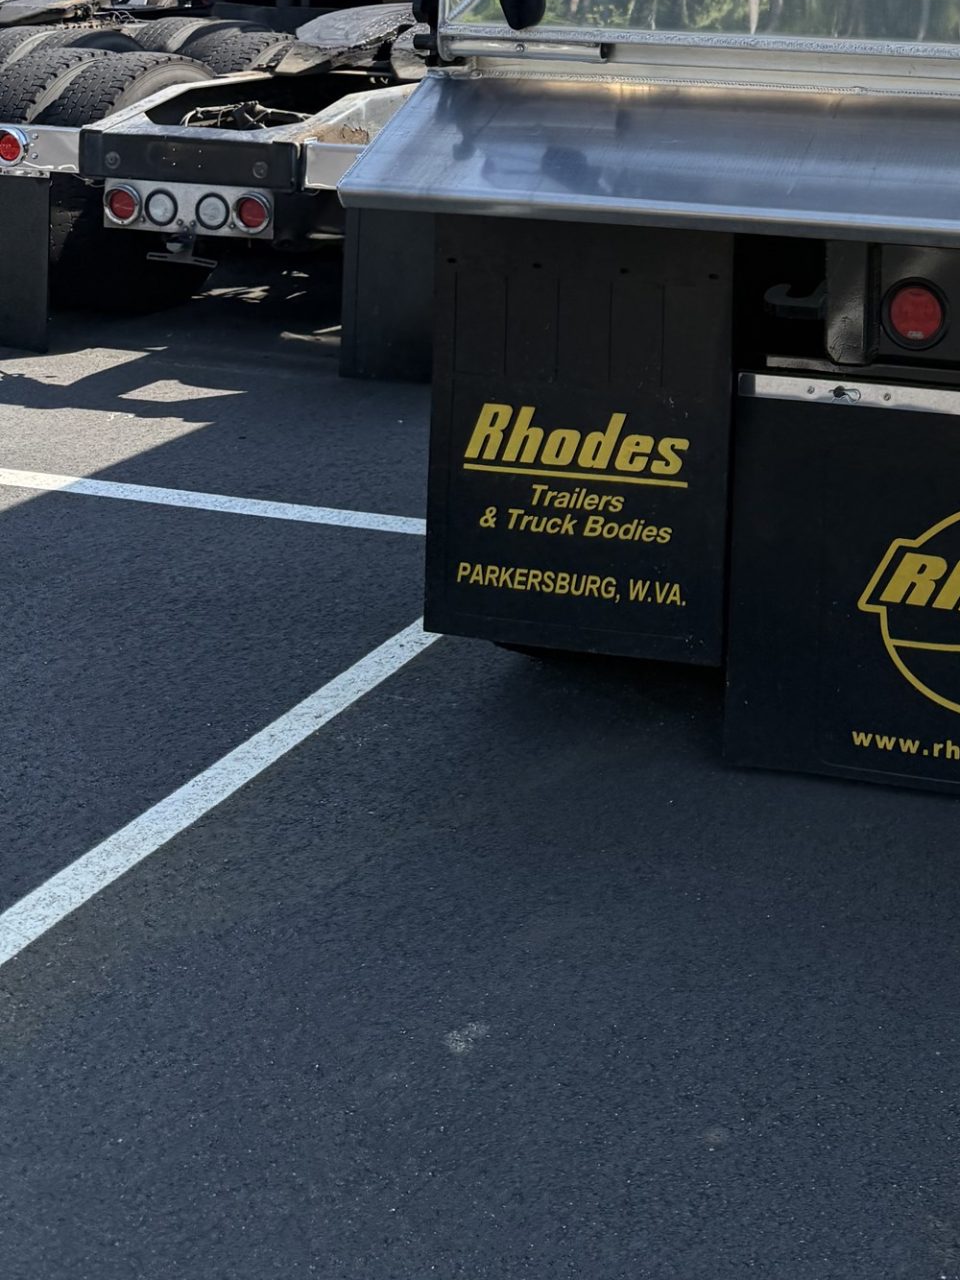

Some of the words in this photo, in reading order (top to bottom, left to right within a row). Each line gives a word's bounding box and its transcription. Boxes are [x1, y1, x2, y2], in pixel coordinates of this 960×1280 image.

[464, 402, 690, 475] Rhodes
[530, 483, 625, 512] Trailers
[479, 506, 497, 528] &
[507, 508, 577, 535] Truck
[583, 515, 673, 544] Bodies
[456, 562, 621, 603] PARKERSBURG,
[628, 579, 687, 607] W.VA.
